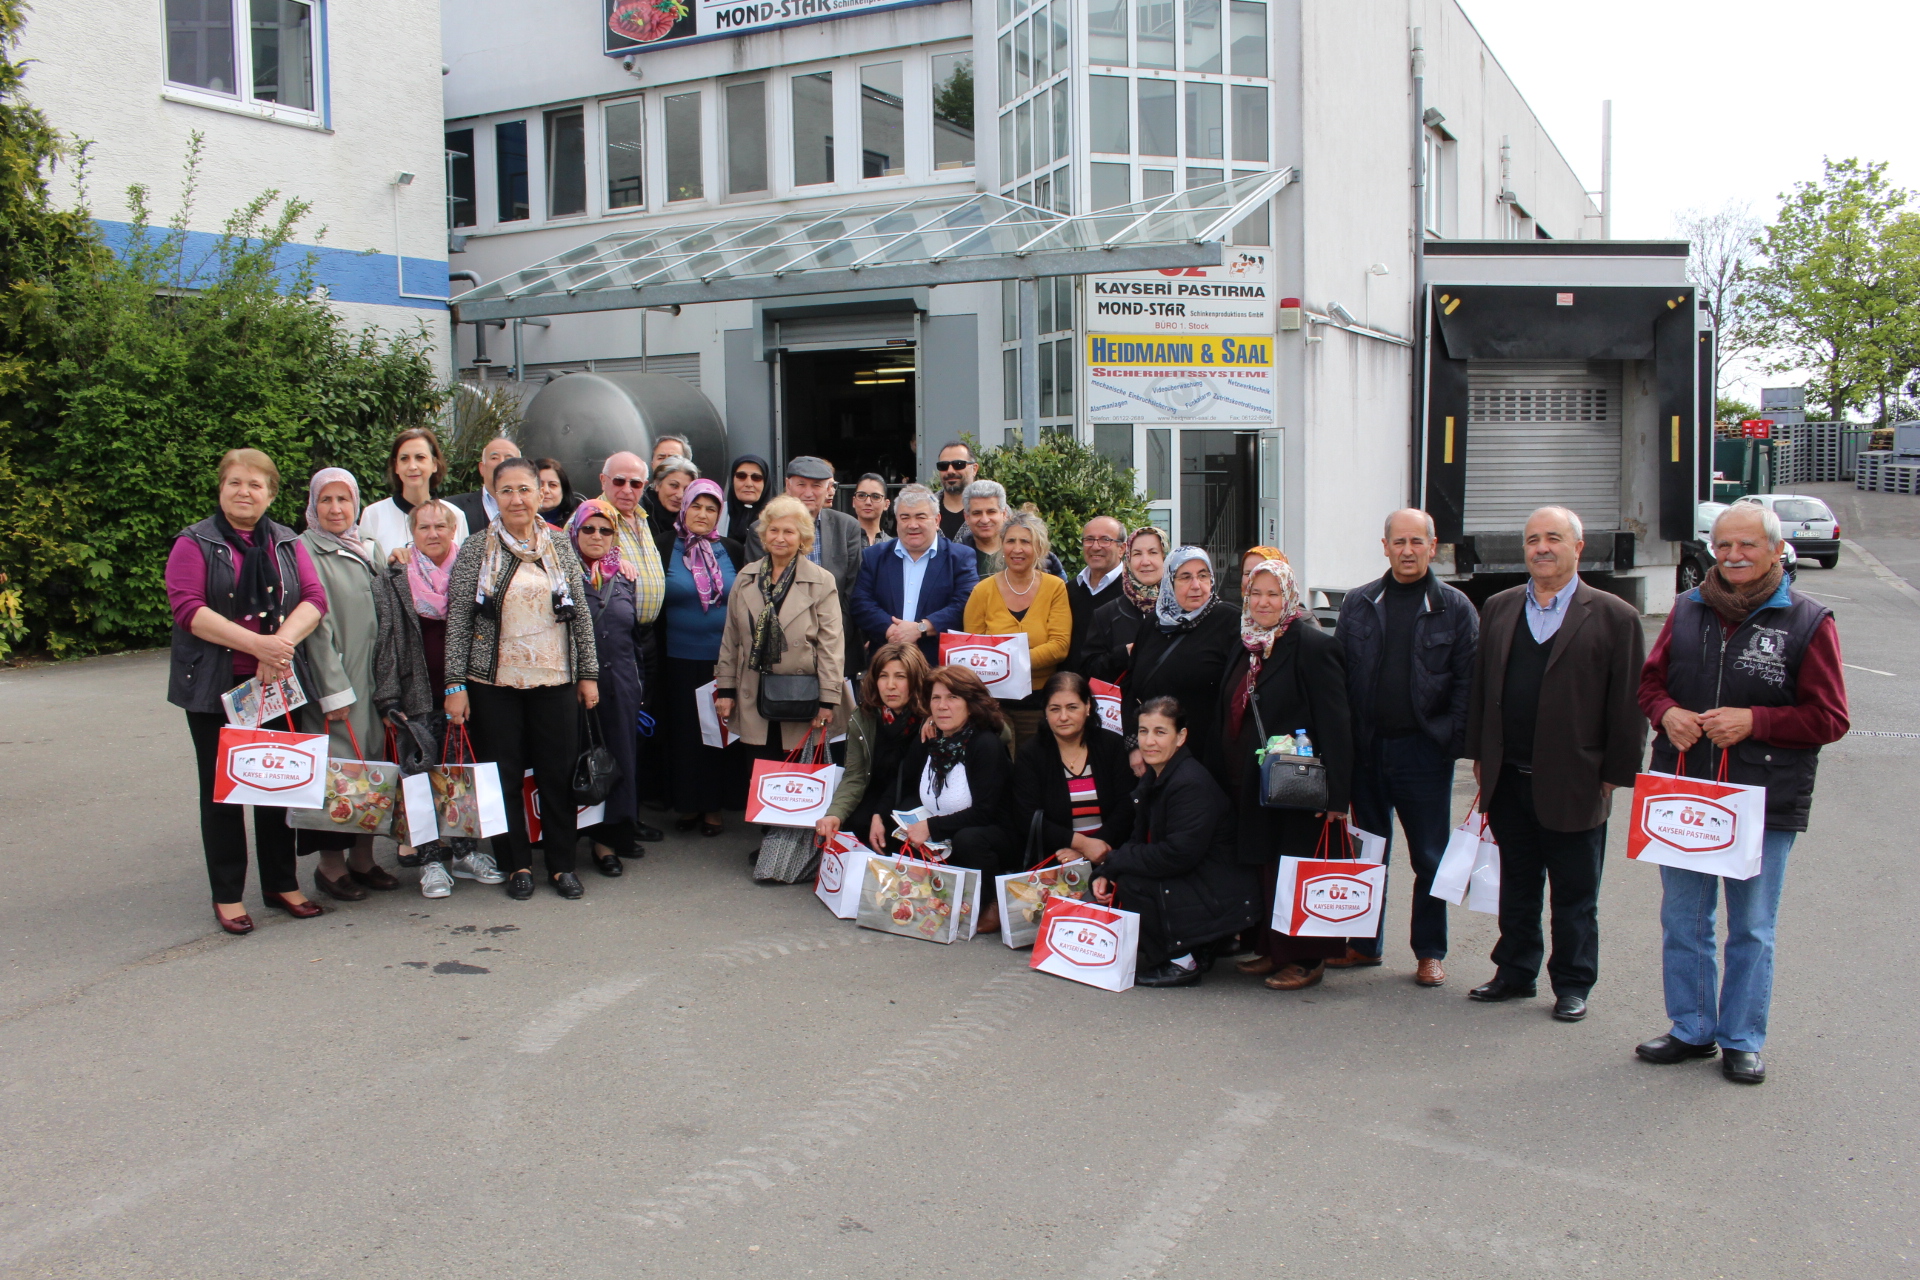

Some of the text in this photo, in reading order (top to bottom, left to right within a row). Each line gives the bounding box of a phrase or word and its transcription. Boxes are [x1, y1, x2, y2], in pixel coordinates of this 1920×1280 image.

[1095, 281, 1266, 298] KAYSERİ PASTIRMA
[1098, 301, 1186, 318] MOND-STAR
[1190, 310, 1247, 319] Schinkenproduktions
[1155, 320, 1178, 329] BÜRO
[1188, 322, 1210, 330] Stock
[1092, 337, 1269, 364] HEIDMANN & SAAL
[1091, 380, 1127, 396] mechanische
[1227, 379, 1271, 395] Netzwerktechnik
[970, 653, 989, 667] ÖZ
[262, 753, 285, 769] ÖZ
[785, 780, 804, 794] ÖZ
[1679, 806, 1706, 827] ÖZ
[1657, 825, 1721, 842] KAYSERİ PASTIRMA
[1329, 884, 1348, 899] ÖZ
[1077, 928, 1098, 945] ÖZ
